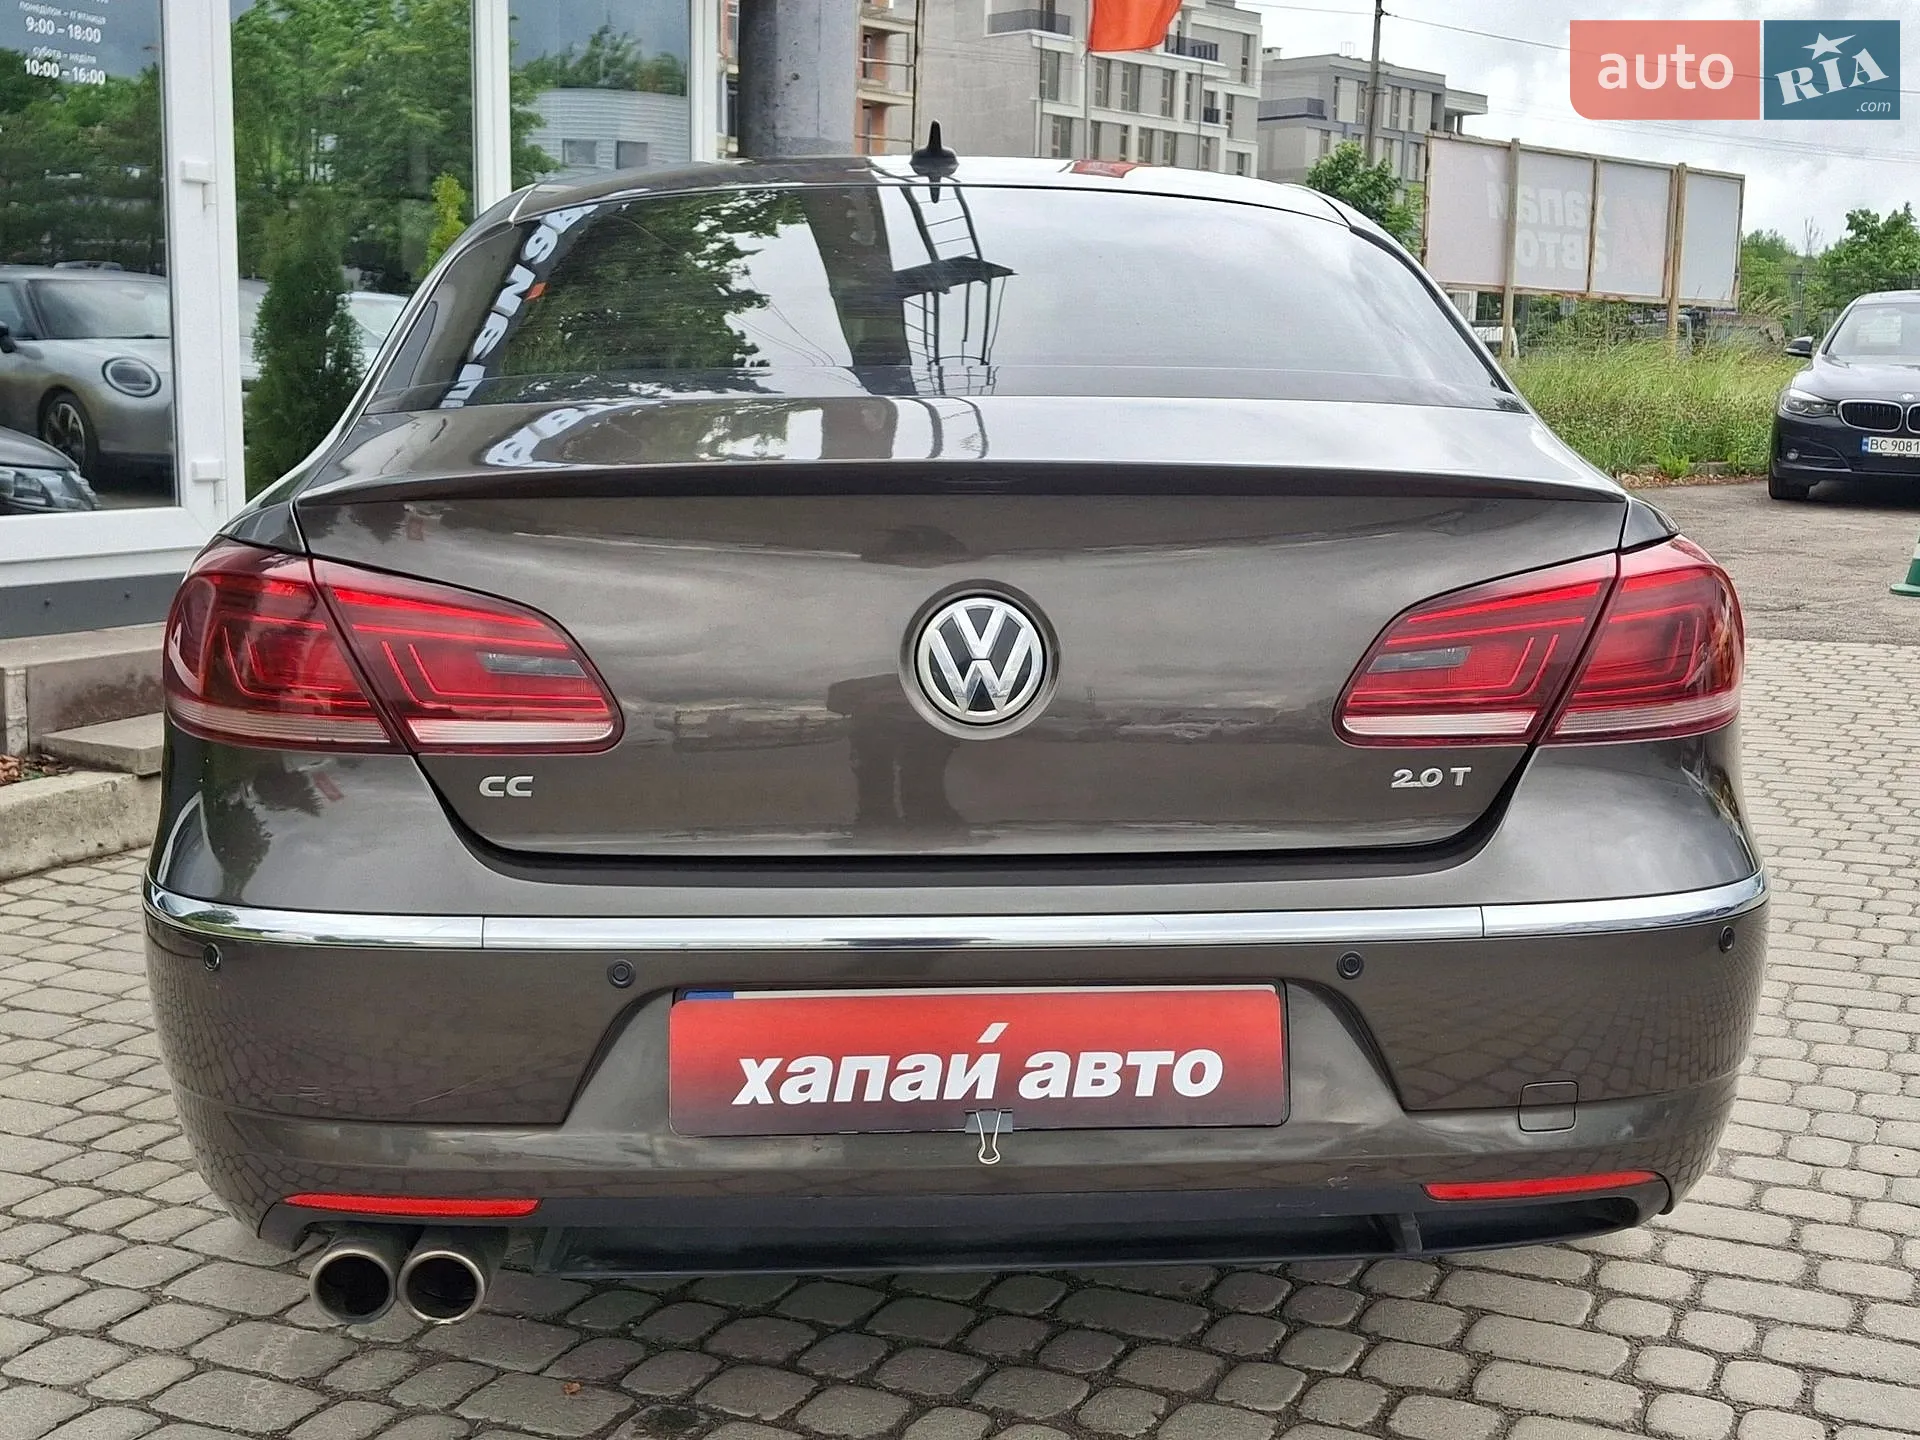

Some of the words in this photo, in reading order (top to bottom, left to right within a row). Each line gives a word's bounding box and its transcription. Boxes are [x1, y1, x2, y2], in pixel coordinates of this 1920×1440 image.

[25, 16, 55, 35] 9:00
[67, 24, 101, 43] 18:00
[24, 59, 60, 78] 10:00
[72, 66, 106, 85] 16:00
[1870, 439, 1888, 451] BC
[1891, 440, 1920, 453] 9081
[479, 775, 534, 797] CC
[1450, 766, 1472, 786] T
[732, 1022, 1009, 1105] хапай
[1017, 1048, 1224, 1101] авто
